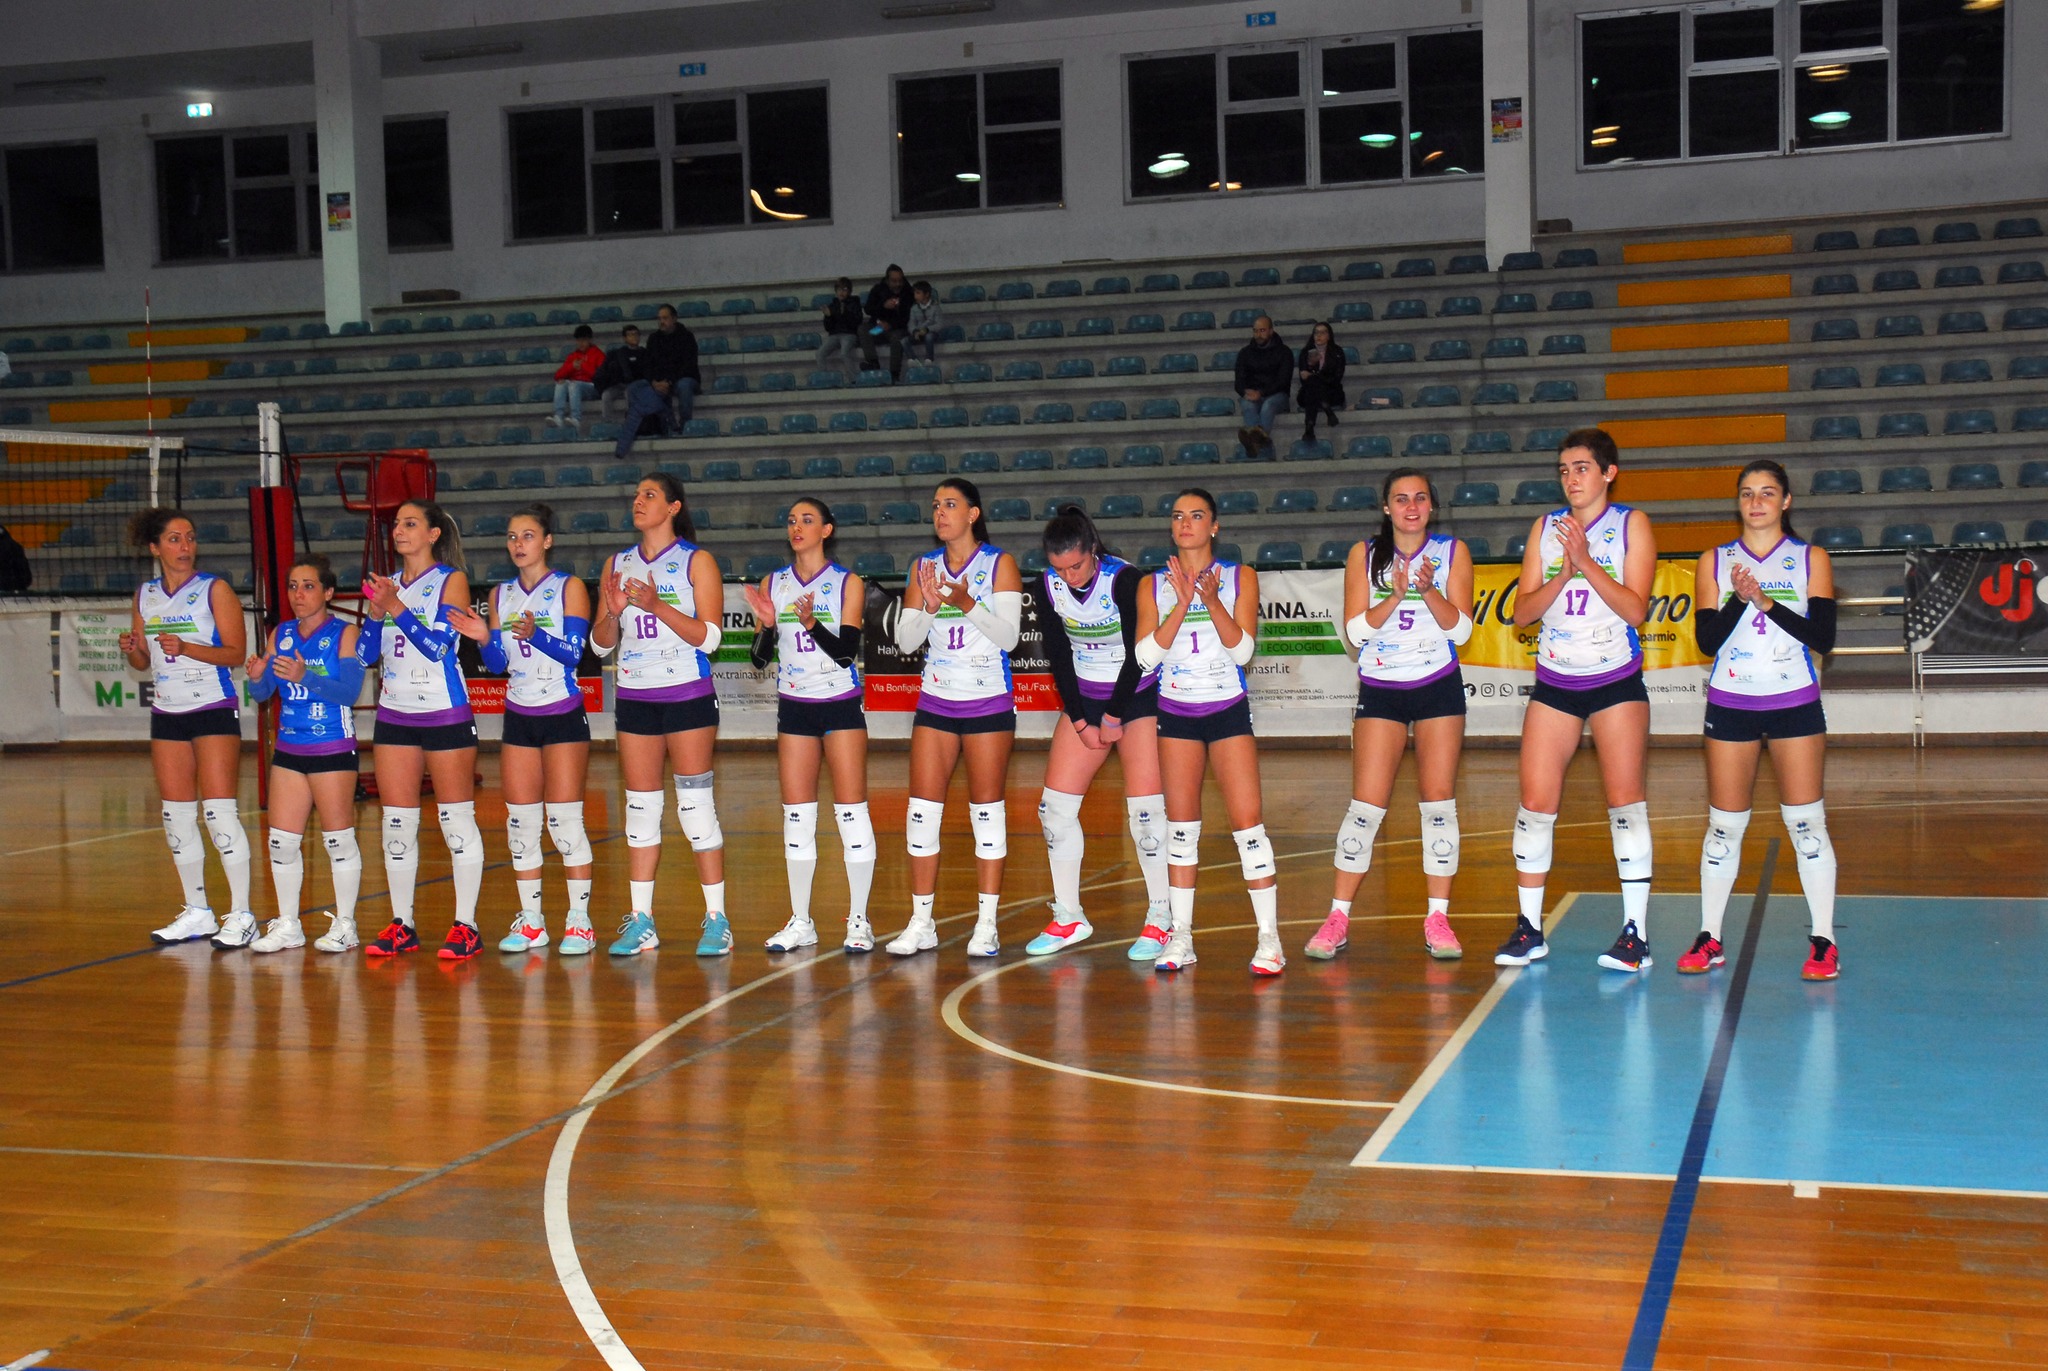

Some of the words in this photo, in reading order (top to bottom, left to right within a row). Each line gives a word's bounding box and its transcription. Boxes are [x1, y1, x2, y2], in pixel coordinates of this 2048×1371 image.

[1759, 581, 1794, 589] RAINA
[1257, 602, 1307, 620] AINA
[1310, 608, 1332, 619] s.r.l.
[1565, 590, 1589, 616] 17
[162, 614, 194, 624] TRAINA
[634, 614, 658, 640] 18
[722, 612, 756, 628] TRA
[1398, 609, 1416, 631] 5
[1751, 611, 1767, 635] 4
[449, 628, 456, 637] 2
[947, 625, 965, 650] 11
[1290, 624, 1324, 634] RIFIUTI
[394, 634, 406, 658] 2
[570, 635, 579, 644] 6
[794, 630, 816, 653] 13
[1190, 631, 1200, 654] 1
[1266, 642, 1326, 652] ECOLOGICI
[517, 640, 532, 658] 6
[872, 683, 885, 692] Via
[886, 683, 921, 694] Bonfiglio
